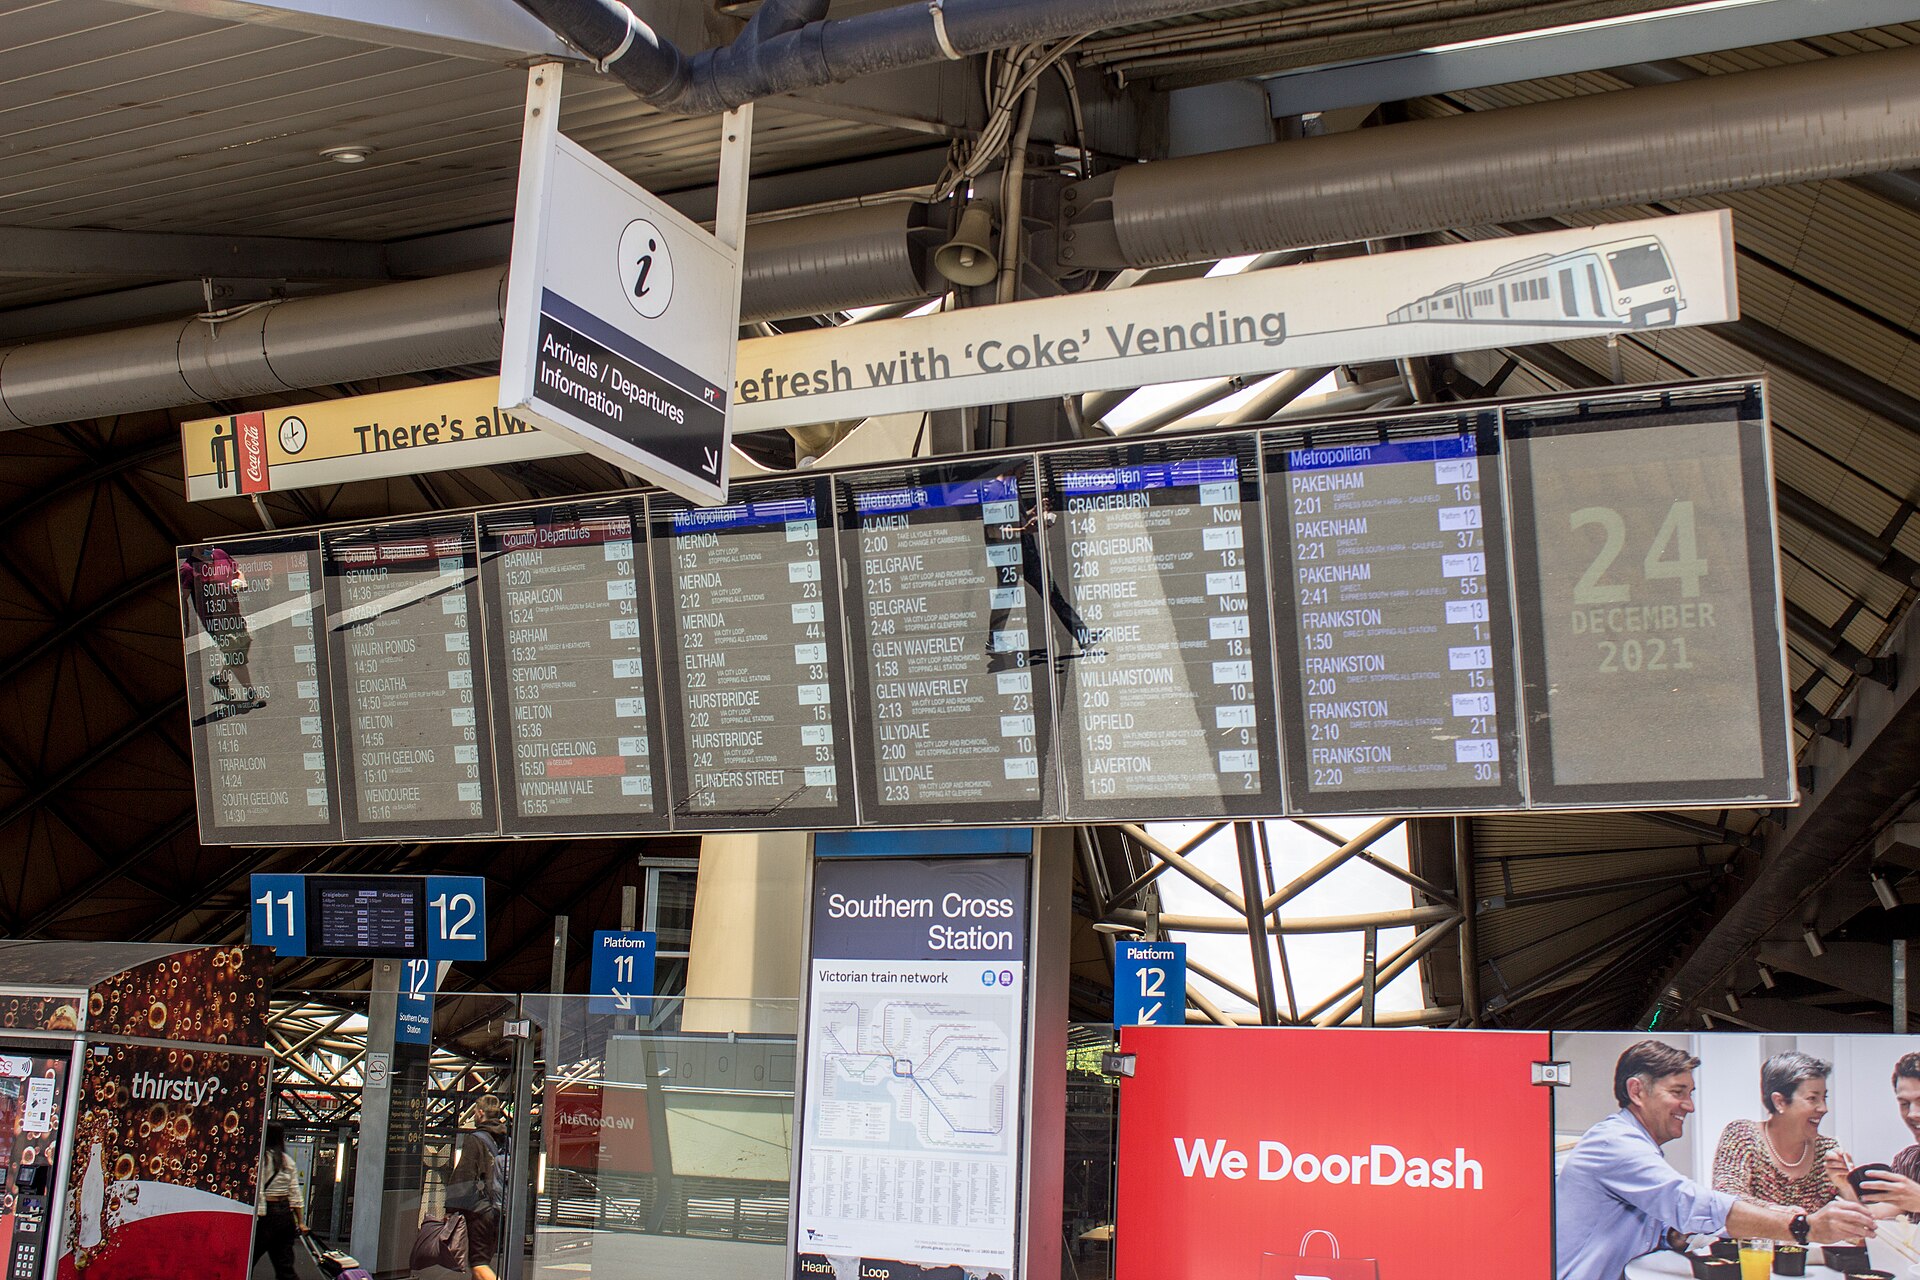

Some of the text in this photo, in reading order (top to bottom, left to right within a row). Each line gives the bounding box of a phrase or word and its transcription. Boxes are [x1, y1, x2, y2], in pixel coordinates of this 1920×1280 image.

[965, 310, 1286, 373] 'Coke' Vending
[542, 333, 684, 424] Arrivals / Departures
[735, 348, 950, 403] efresh with
[541, 361, 623, 421] Information
[354, 415, 463, 454] There's
[1291, 446, 1371, 467] Metropolitan
[1067, 469, 1140, 489] Metropolitan
[1293, 472, 1364, 493] PAKENHAM
[860, 490, 928, 509] Metropolitan
[1068, 492, 1150, 514] CRAIGIEBURN
[1294, 484, 1471, 515] 2:01 16
[675, 510, 736, 527] Metropolitan
[863, 515, 909, 533] ALAMEIN
[1071, 507, 1241, 534] 1:48 Now
[503, 528, 590, 547] Country Departures
[1296, 518, 1367, 539] PAKENHAM
[677, 533, 719, 550] MERNDA
[864, 537, 888, 553] 2:00
[1072, 537, 1153, 558] CRAIGIEBURN
[1298, 531, 1474, 560] 2:21 37
[505, 552, 543, 567] BARMAH
[678, 554, 697, 568] 1:52
[1569, 500, 1709, 605] 24
[866, 556, 924, 575] BELGRAVE
[1074, 551, 1236, 578] 2:08 18
[1300, 563, 1371, 584] PAKENHAM
[346, 567, 388, 584] SEYMOUR
[506, 570, 531, 585] 15:20
[679, 573, 722, 590] MERNDA
[867, 567, 1017, 594] 2:15 25
[507, 588, 563, 606] TRARALGON
[681, 583, 817, 608] 2:12 23
[1075, 581, 1137, 601] WERRIBEE
[1301, 578, 1478, 605] 2:41 55
[869, 598, 927, 616] BELGRAVE
[683, 613, 725, 629] MERNDA
[871, 620, 895, 635] 2:48
[1303, 609, 1381, 629] FRANKSTON
[1571, 603, 1716, 634] DECEMBER
[510, 628, 548, 644] BARHAM
[684, 633, 703, 648] 2:32
[1078, 626, 1140, 644] WERRIBEE
[1305, 633, 1332, 650] 1:50
[352, 639, 415, 656] WAURN PONDS
[873, 636, 965, 658] GLEN WAVERLEY
[1598, 637, 1693, 673] 2021
[209, 652, 244, 666] BENDIGO
[686, 653, 725, 669] ELTHAM
[1306, 655, 1384, 674] FRANKSTON
[512, 666, 557, 681] SEYMOUR
[687, 665, 823, 687] 2:22 33
[875, 661, 898, 677] 1:58
[1081, 668, 1173, 687] WILLIAMSTOWN
[356, 677, 407, 693] LEONGATHA
[876, 679, 968, 699] GLEN WAVERLEY
[1308, 671, 1484, 696] 2:00 15
[689, 691, 760, 709] HURSTBRIDGE
[878, 695, 1028, 718] 2:13 23
[1083, 691, 1109, 708] 2:00
[515, 705, 552, 720] MELTON
[690, 706, 826, 727] 2:02 15
[1309, 701, 1388, 720] FRANKSTON
[216, 723, 247, 736] MELTON
[359, 715, 393, 730] MELTON
[517, 723, 542, 737] 15:36
[1085, 713, 1134, 731] UPFIELD
[1311, 718, 1486, 741] 2:10 21
[361, 733, 384, 746] 14:56
[692, 731, 763, 748] HURSTBRIDGE
[880, 723, 930, 740] LILYDALE
[518, 741, 596, 758] SOUTH GEELONG
[882, 738, 1031, 759] 2:00 10
[1087, 735, 1112, 751] 1:59
[219, 757, 266, 771] TRARALGON
[362, 749, 434, 766] SOUTH GEELONG
[694, 753, 712, 767] 2:42
[1313, 746, 1391, 764] FRANKSTON
[520, 762, 544, 775] 15:50
[884, 765, 934, 782] LILYDALE
[1088, 757, 1151, 774] LAVERTON
[695, 770, 784, 788] FLINDERS STREET
[1315, 764, 1491, 786] 2:20 30
[365, 787, 420, 802] WENDOUREE
[520, 780, 594, 795] WYNDHAM VALE
[1091, 778, 1115, 794] 1:50
[222, 792, 288, 806] SOUTH GEELONG
[368, 806, 391, 820] 15:16
[256, 891, 295, 936] 11
[828, 892, 1014, 918] Southern Cross
[430, 893, 477, 940] 12
[603, 937, 645, 948] Platform
[928, 924, 1013, 950] Station
[1127, 947, 1175, 961] Platform
[614, 955, 634, 983] 11
[819, 970, 948, 984] Victorian train network
[408, 959, 429, 1001] 12
[1135, 967, 1166, 998] 12
[400, 1012, 429, 1025] Southern Cross
[407, 1024, 421, 1034] Station
[132, 1071, 221, 1107] thirsty?
[1173, 1137, 1484, 1190] We DoorDash
[801, 1260, 889, 1280] Hearin Loop
